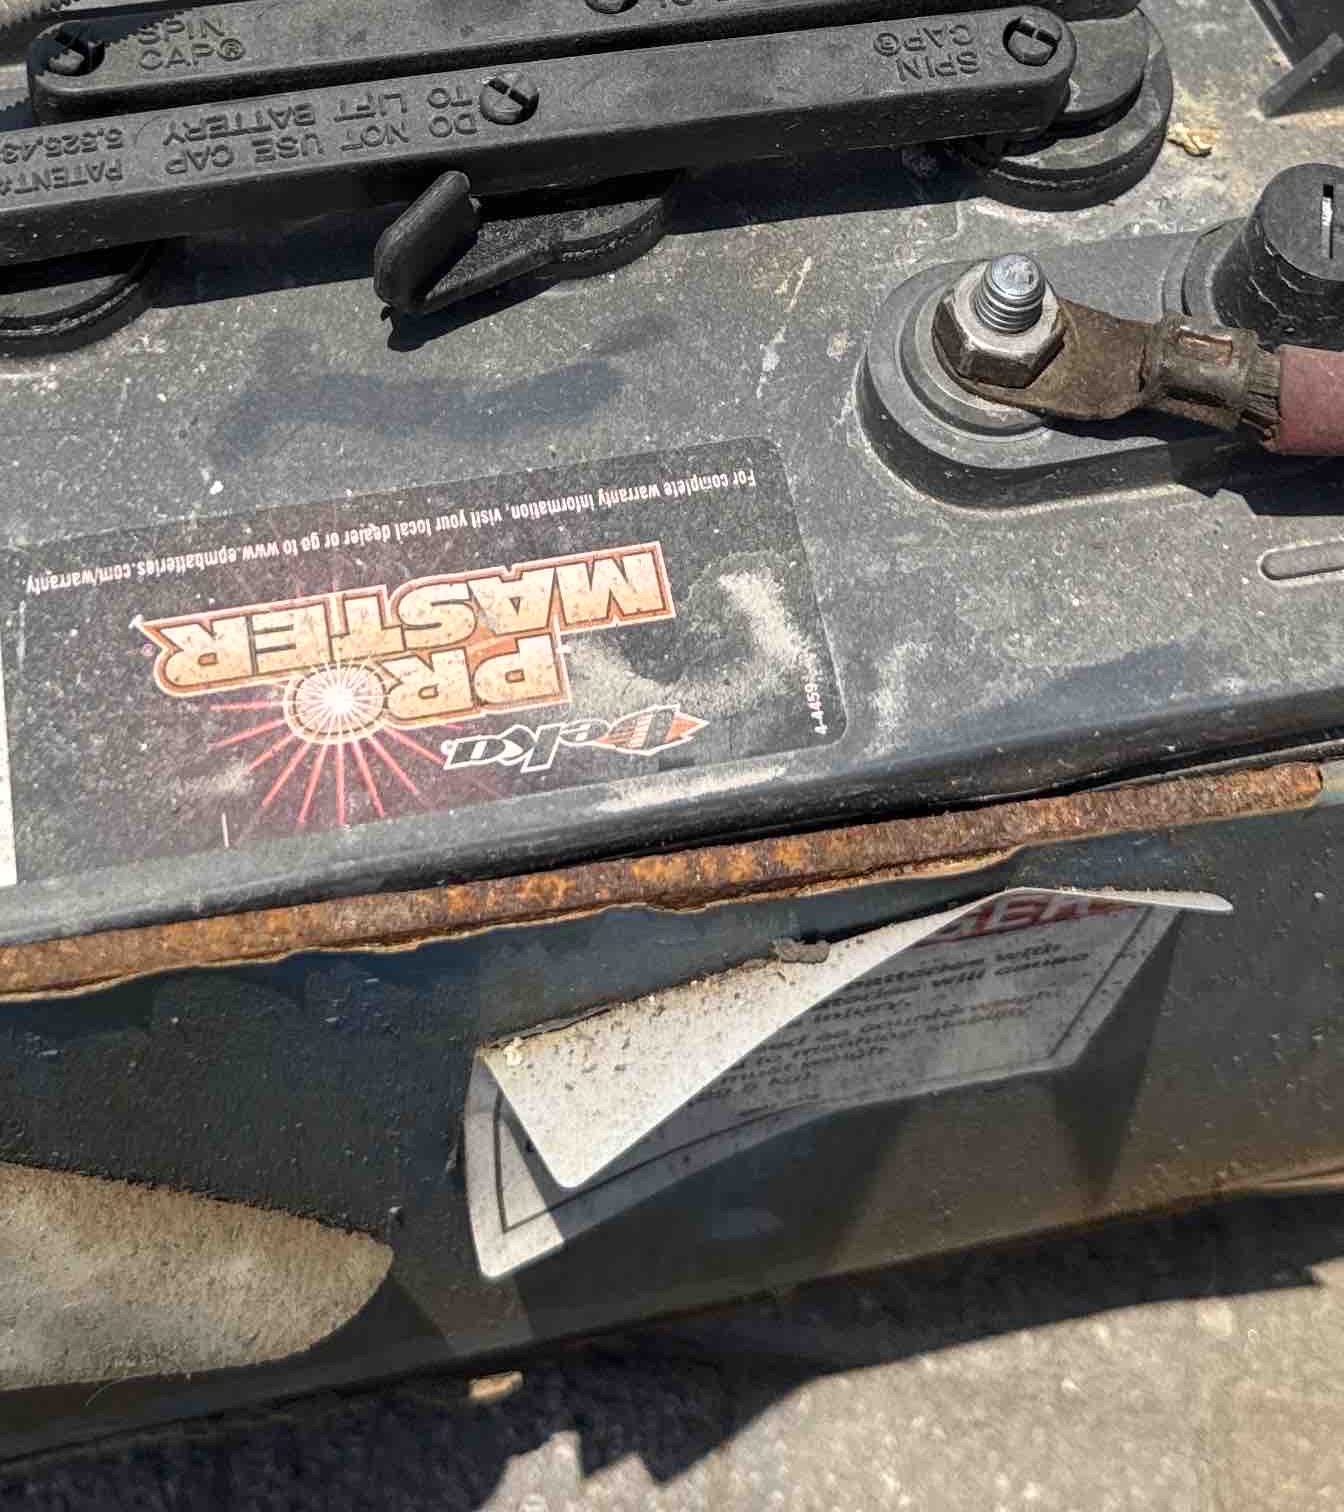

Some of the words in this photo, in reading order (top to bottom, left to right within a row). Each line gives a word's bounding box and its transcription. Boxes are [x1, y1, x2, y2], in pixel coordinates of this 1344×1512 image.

[894, 47, 978, 83] SPIN
[335, 89, 407, 123] LIFT
[425, 82, 474, 111] TO
[157, 100, 316, 147] BATTERY
[340, 119, 409, 152] NOT
[426, 110, 477, 141] DO
[161, 143, 235, 176] CAP
[245, 129, 321, 164] USE
[596, 479, 660, 507] warranty
[661, 469, 730, 498] complete
[730, 468, 755, 488] For
[433, 508, 467, 533] your
[468, 506, 502, 530] visit
[504, 490, 596, 524] information,
[299, 529, 319, 550] go
[322, 530, 339, 547] or
[341, 520, 391, 548] dealer
[393, 517, 431, 541] local
[279, 536, 297, 557] to
[142, 541, 675, 698] MASTER
[283, 634, 565, 743] PRO
[441, 702, 710, 773] Deka
